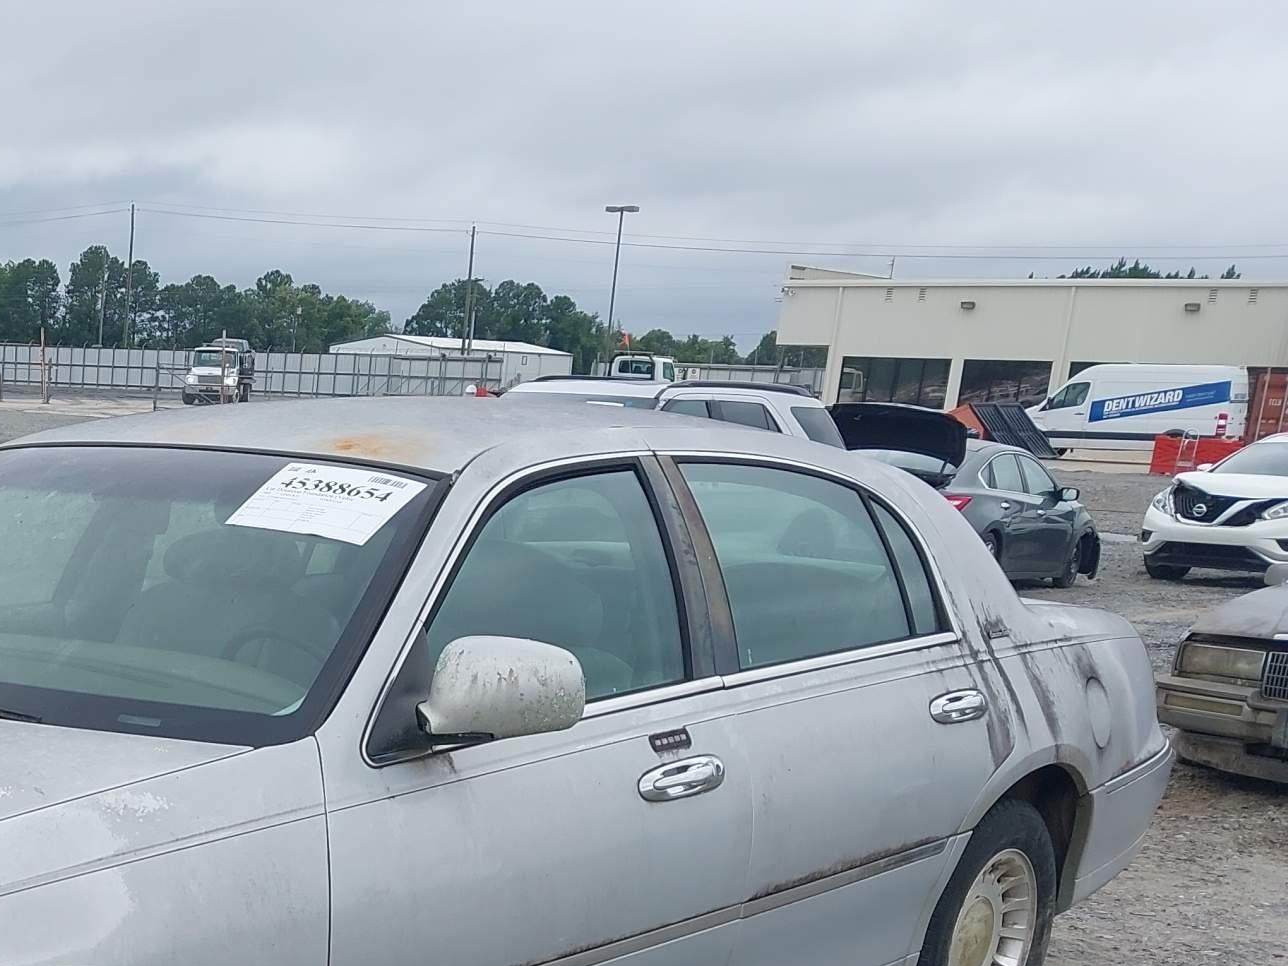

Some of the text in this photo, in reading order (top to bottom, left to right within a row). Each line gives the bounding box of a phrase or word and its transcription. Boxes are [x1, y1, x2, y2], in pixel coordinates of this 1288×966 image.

[1103, 396, 1136, 412] DENT
[1134, 389, 1184, 407] WIZARD
[281, 476, 393, 502] 45388654
